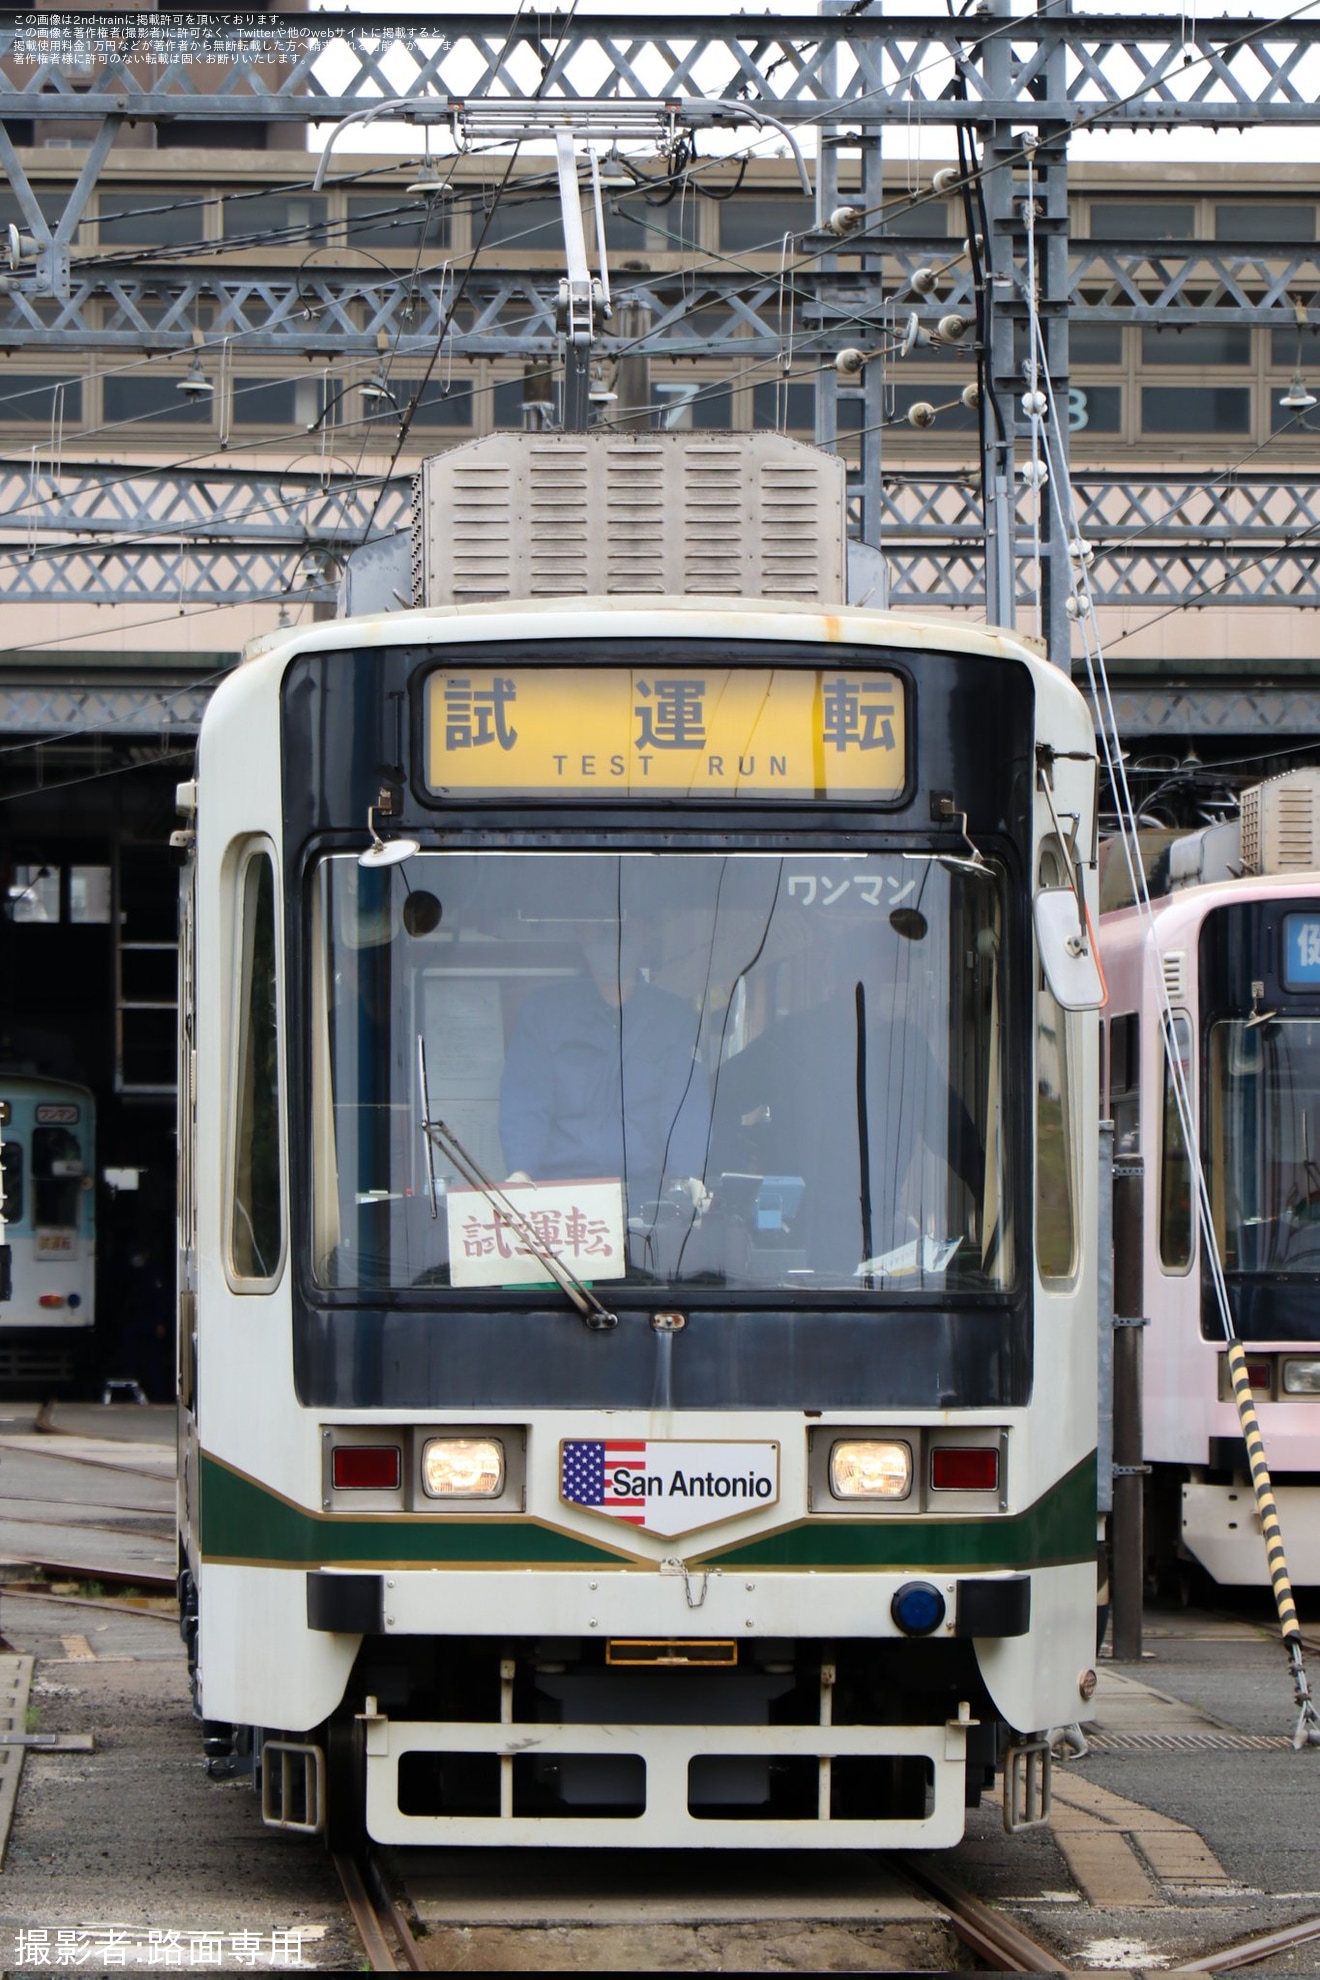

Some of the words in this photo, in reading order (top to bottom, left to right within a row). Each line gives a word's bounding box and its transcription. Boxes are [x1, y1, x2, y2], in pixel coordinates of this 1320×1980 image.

[655, 384, 701, 428] 7
[444, 676, 896, 753] 試運転
[552, 755, 654, 777] TEST
[708, 755, 788, 777] RUN
[788, 875, 916, 906] ワンマン
[462, 1206, 614, 1260] 試運転
[613, 1469, 663, 1498] San
[669, 1470, 772, 1498] Antonio
